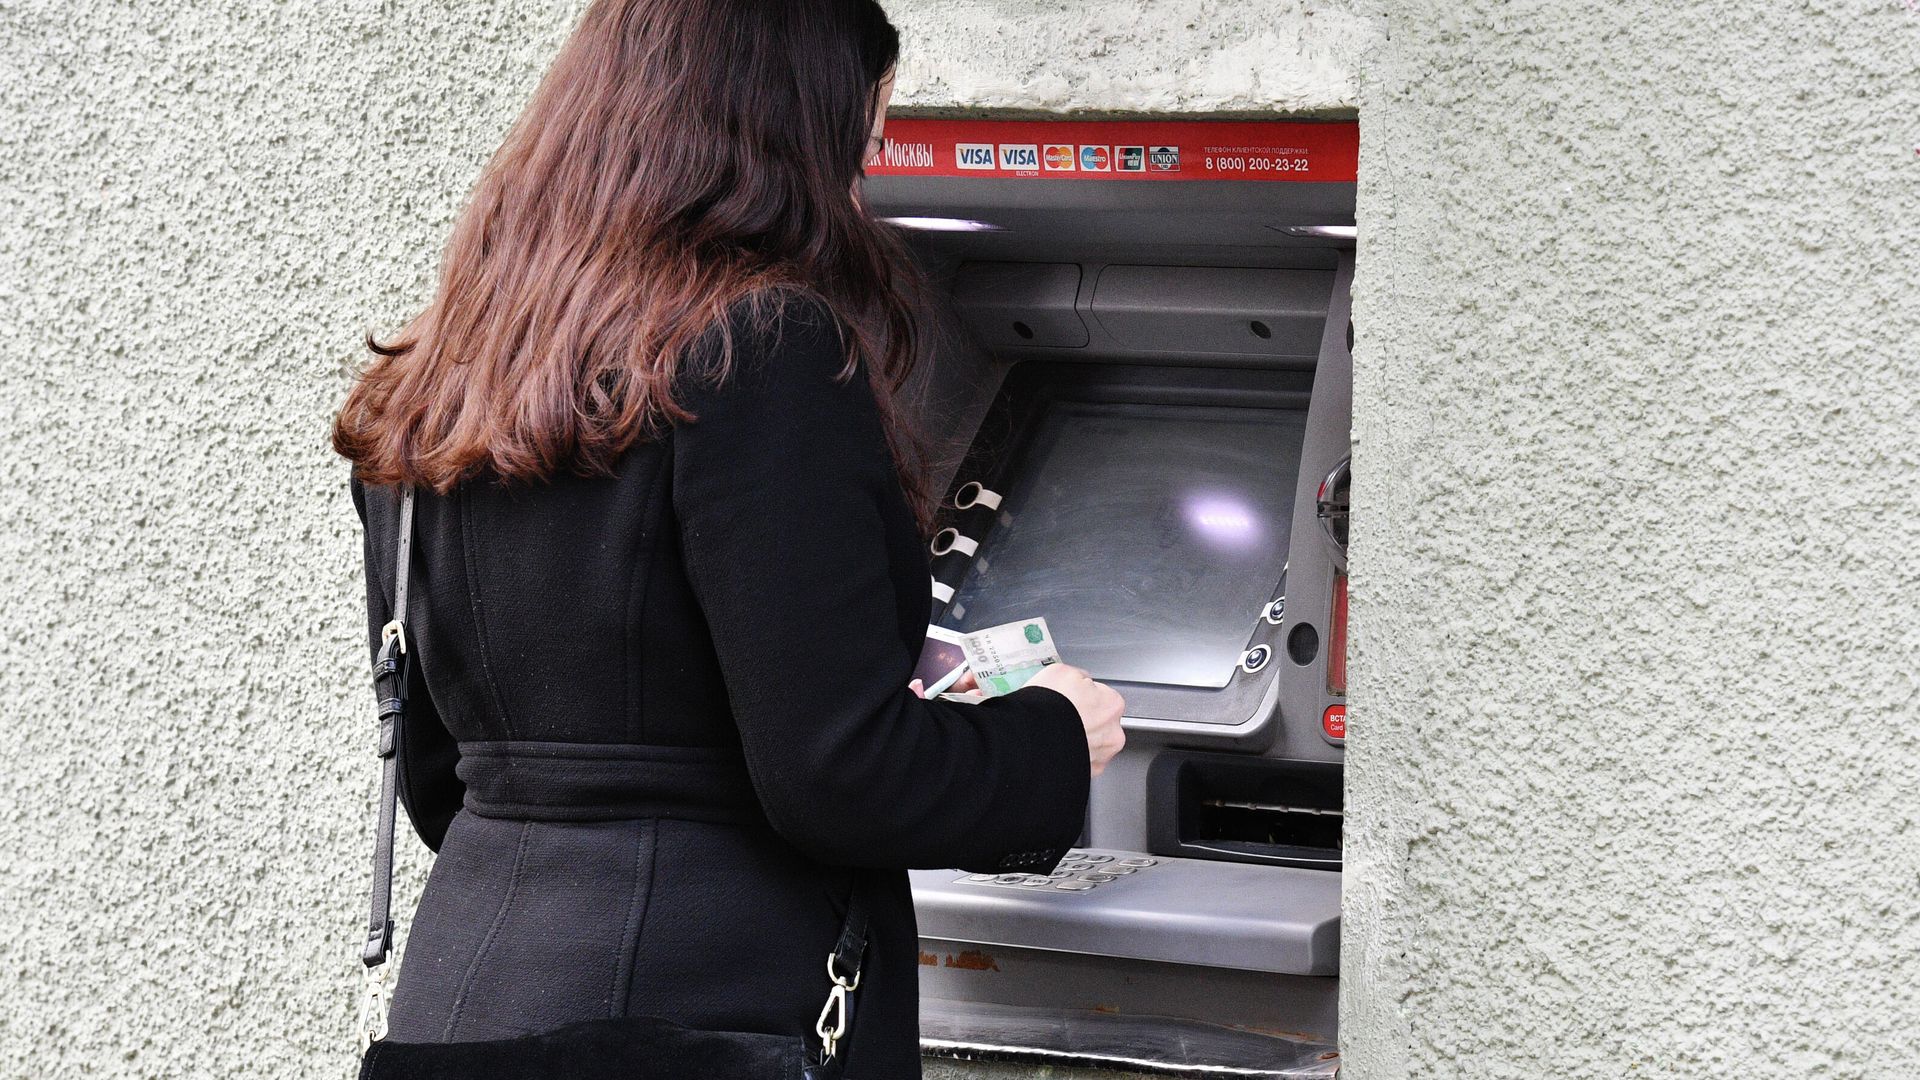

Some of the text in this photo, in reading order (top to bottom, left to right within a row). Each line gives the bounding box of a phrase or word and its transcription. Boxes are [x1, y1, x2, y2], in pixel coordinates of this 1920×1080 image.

[960, 148, 993, 165] VISA
[1003, 148, 1037, 166] VISA
[1151, 154, 1178, 164] UNION
[1205, 157, 1309, 172] 8 (800) 200-23-22
